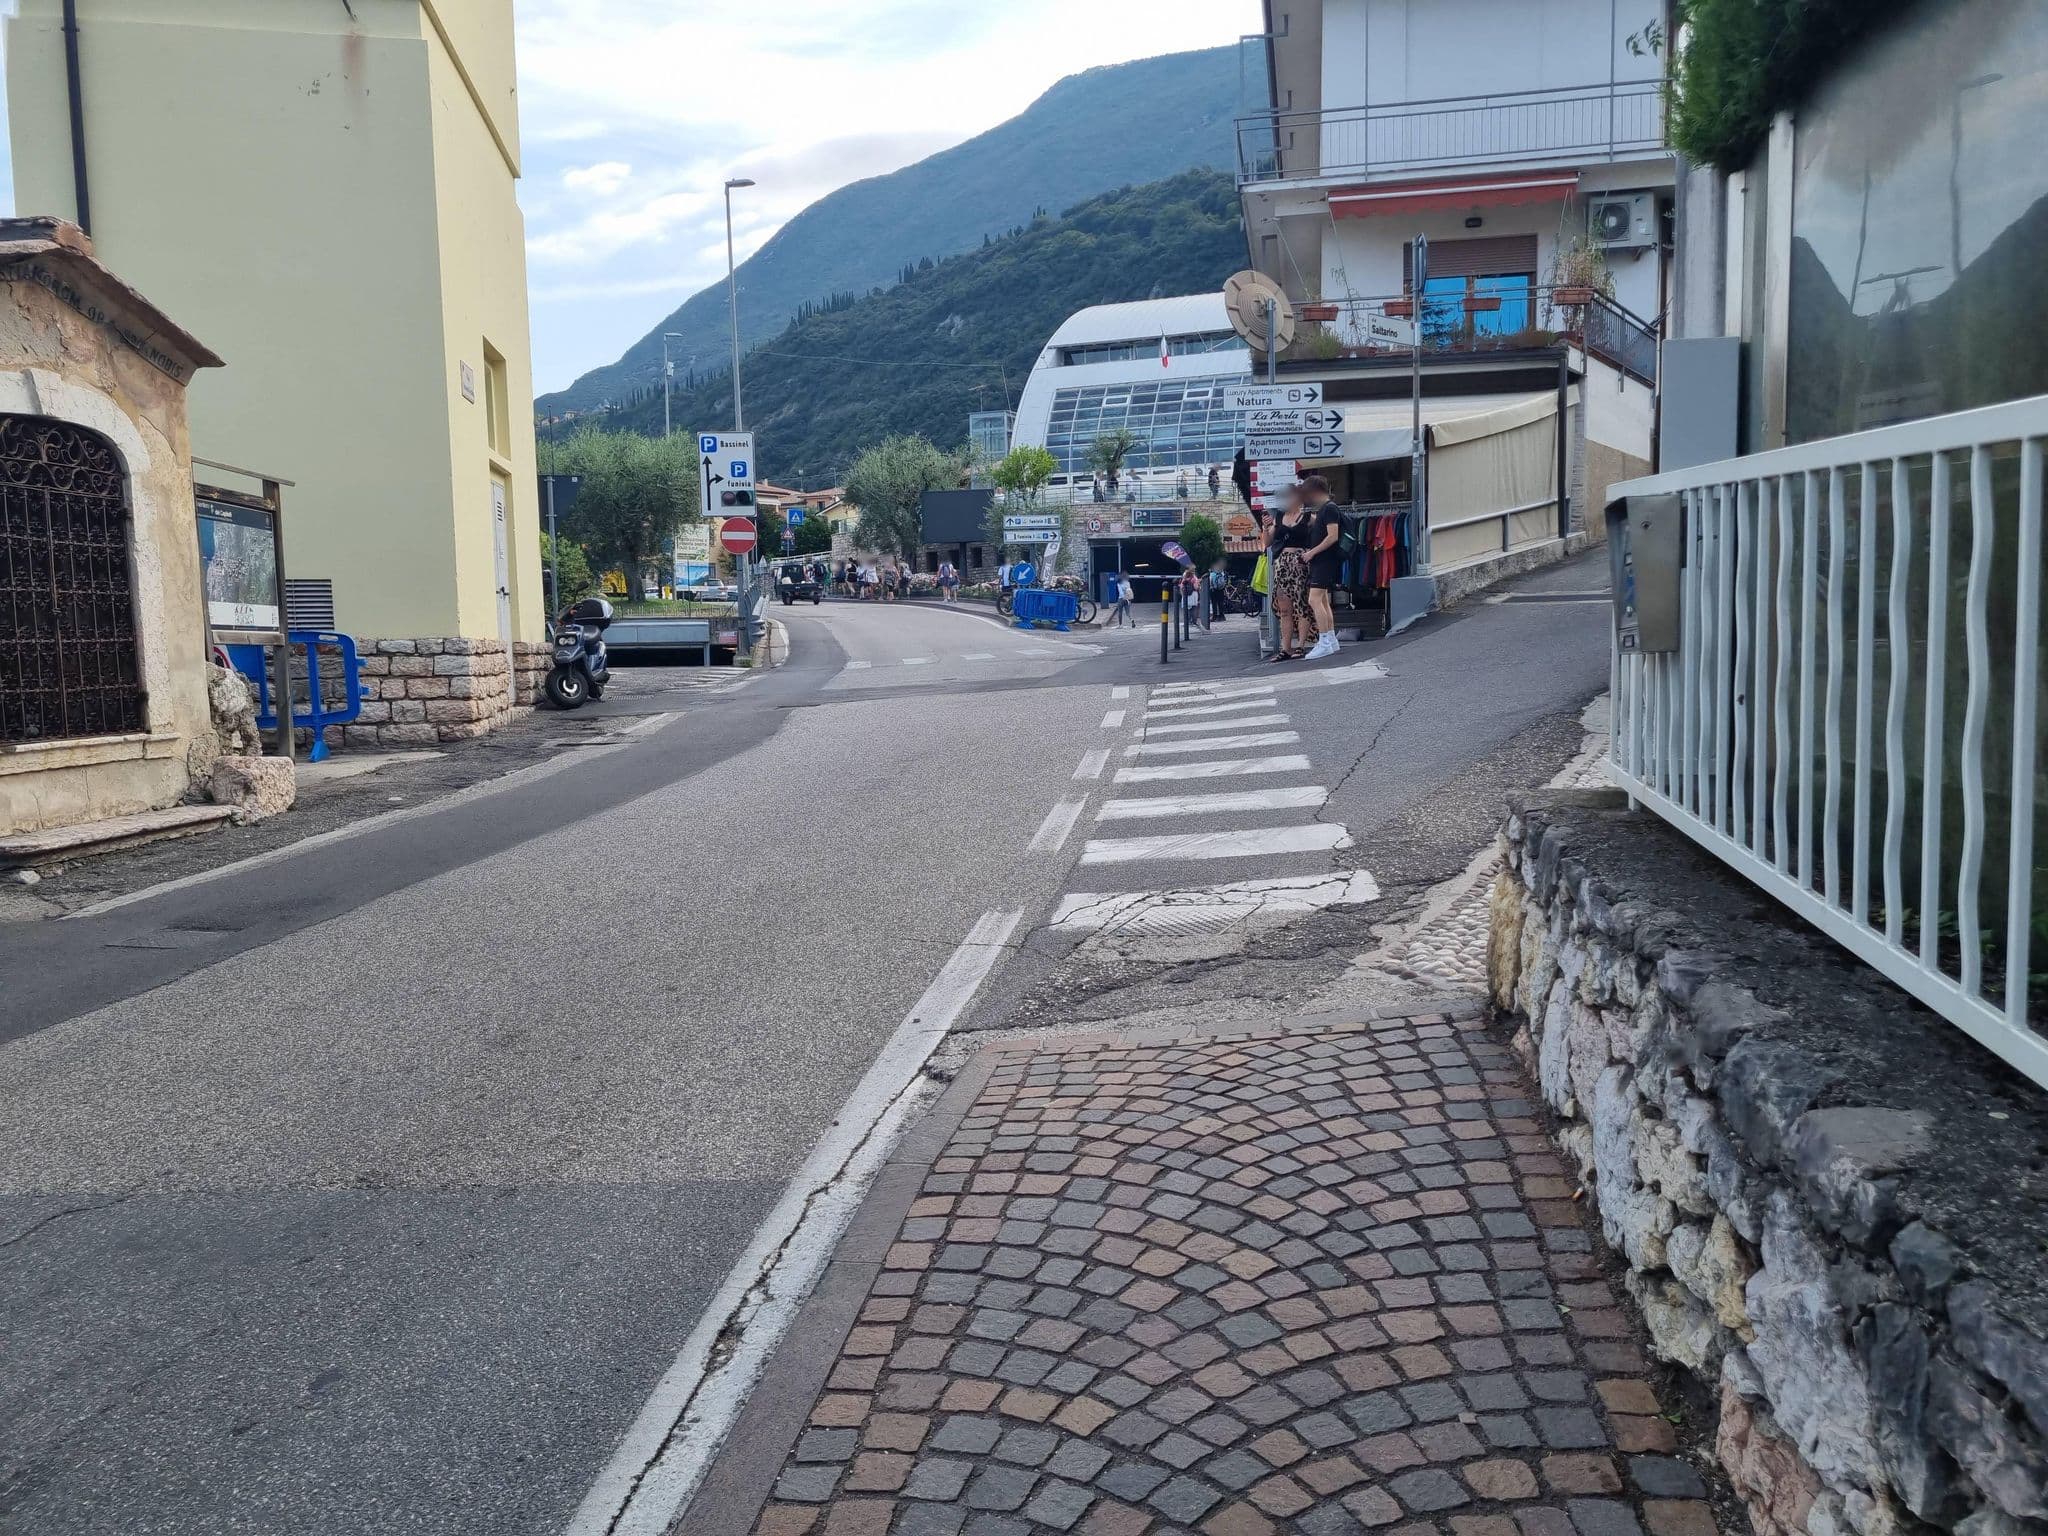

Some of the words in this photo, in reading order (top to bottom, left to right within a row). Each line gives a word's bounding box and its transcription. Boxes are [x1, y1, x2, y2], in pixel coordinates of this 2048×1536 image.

[1247, 388, 1283, 396] Apartments
[1236, 397, 1272, 406] Natura
[1250, 411, 1267, 420] La
[1269, 410, 1300, 420] Perla
[1249, 438, 1297, 447] Apartments
[1249, 448, 1261, 456] My
[1263, 447, 1290, 455] Dream
